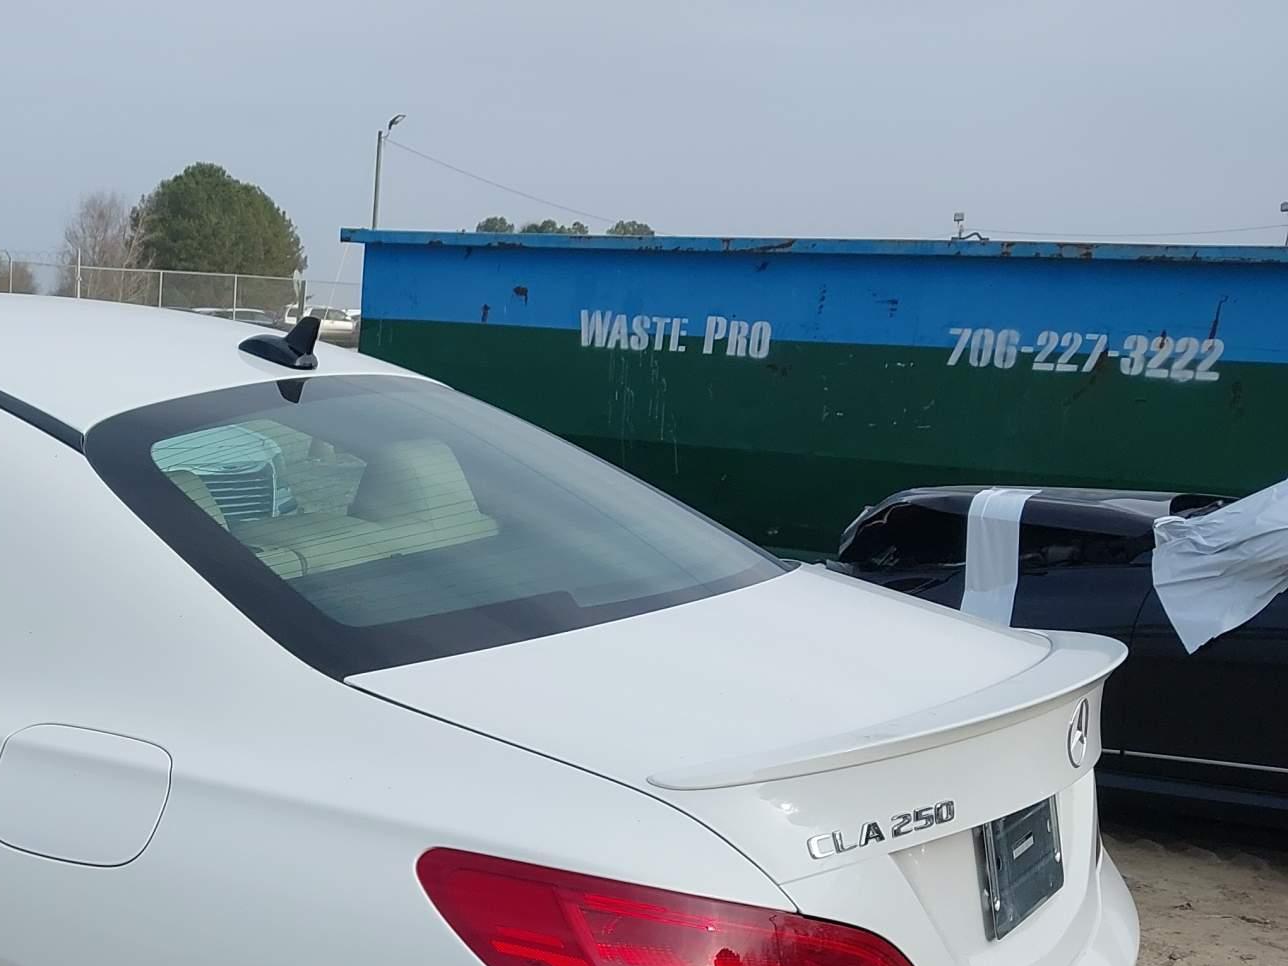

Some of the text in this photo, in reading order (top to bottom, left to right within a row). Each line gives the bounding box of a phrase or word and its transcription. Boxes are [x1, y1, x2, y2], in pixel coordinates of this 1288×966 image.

[580, 309, 773, 359] WASTE PRO
[946, 327, 1225, 382] 706-227-3222
[806, 800, 955, 860] CLA 250
